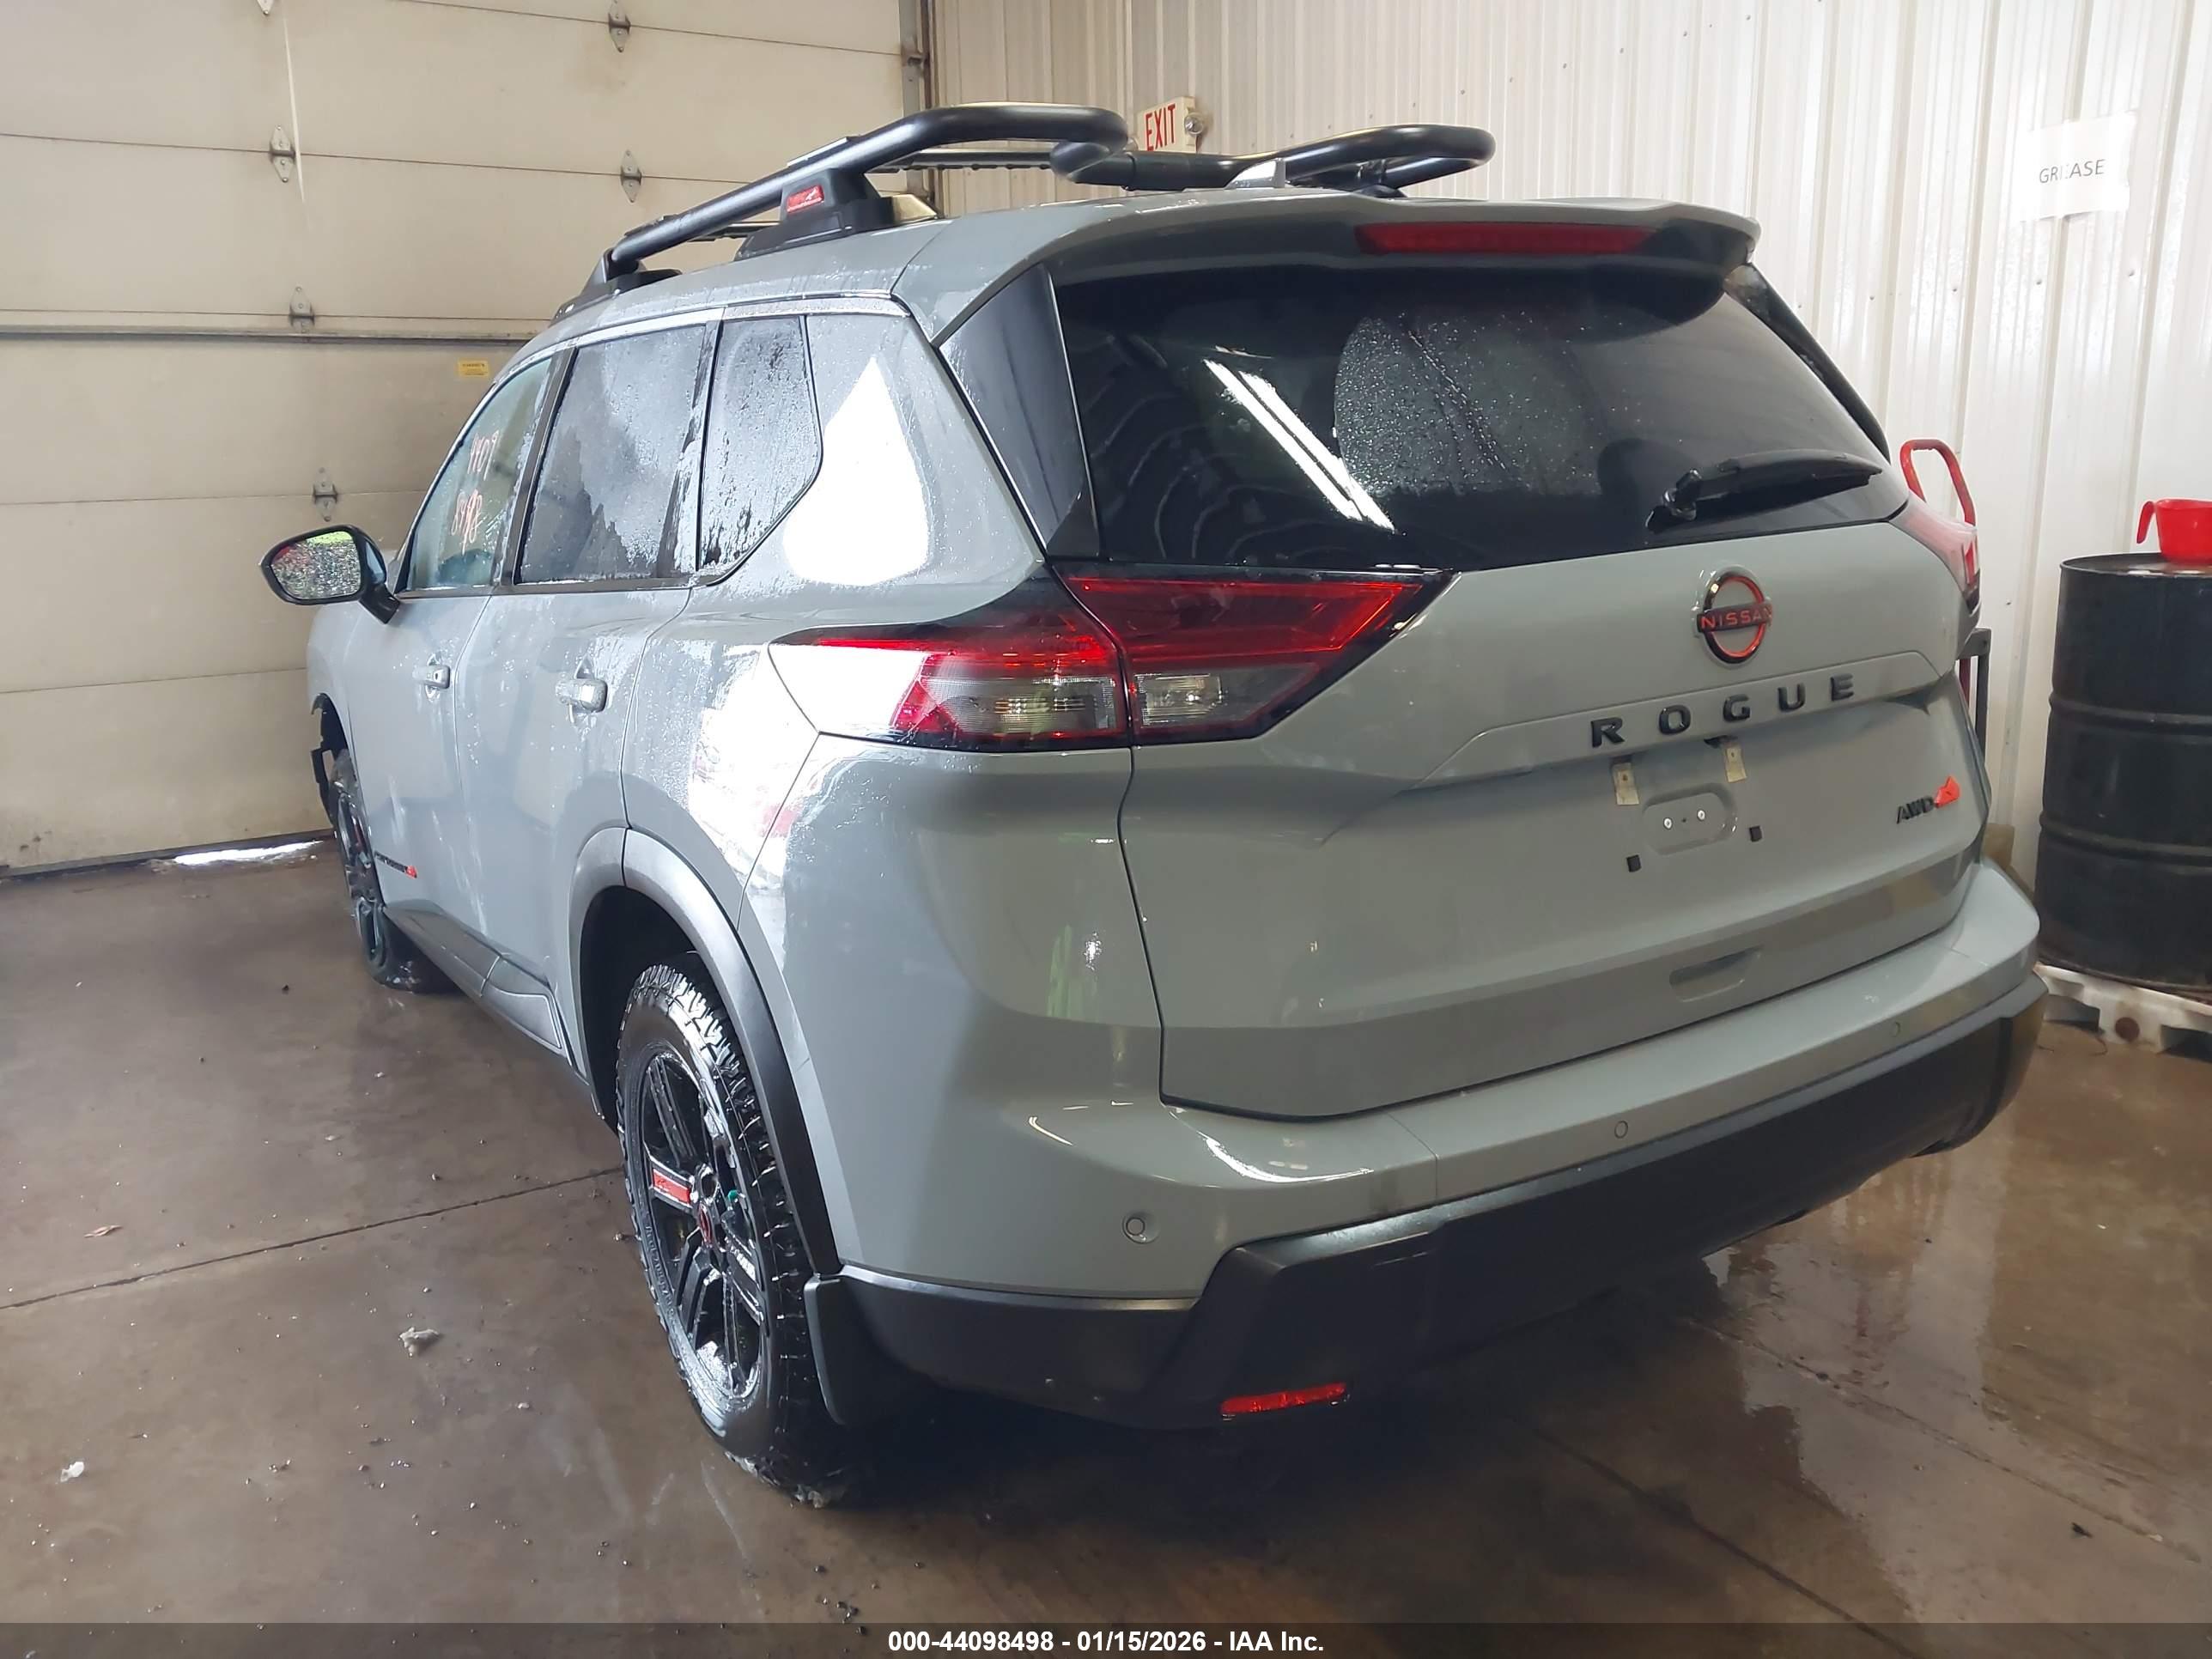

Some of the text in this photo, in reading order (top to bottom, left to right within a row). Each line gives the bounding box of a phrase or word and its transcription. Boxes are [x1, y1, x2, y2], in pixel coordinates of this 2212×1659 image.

[1146, 103, 1176, 151] EXIT
[1700, 604, 1772, 629] NISSAN
[1590, 673, 1855, 747] ROGUE
[1896, 796, 1935, 824] AWD
